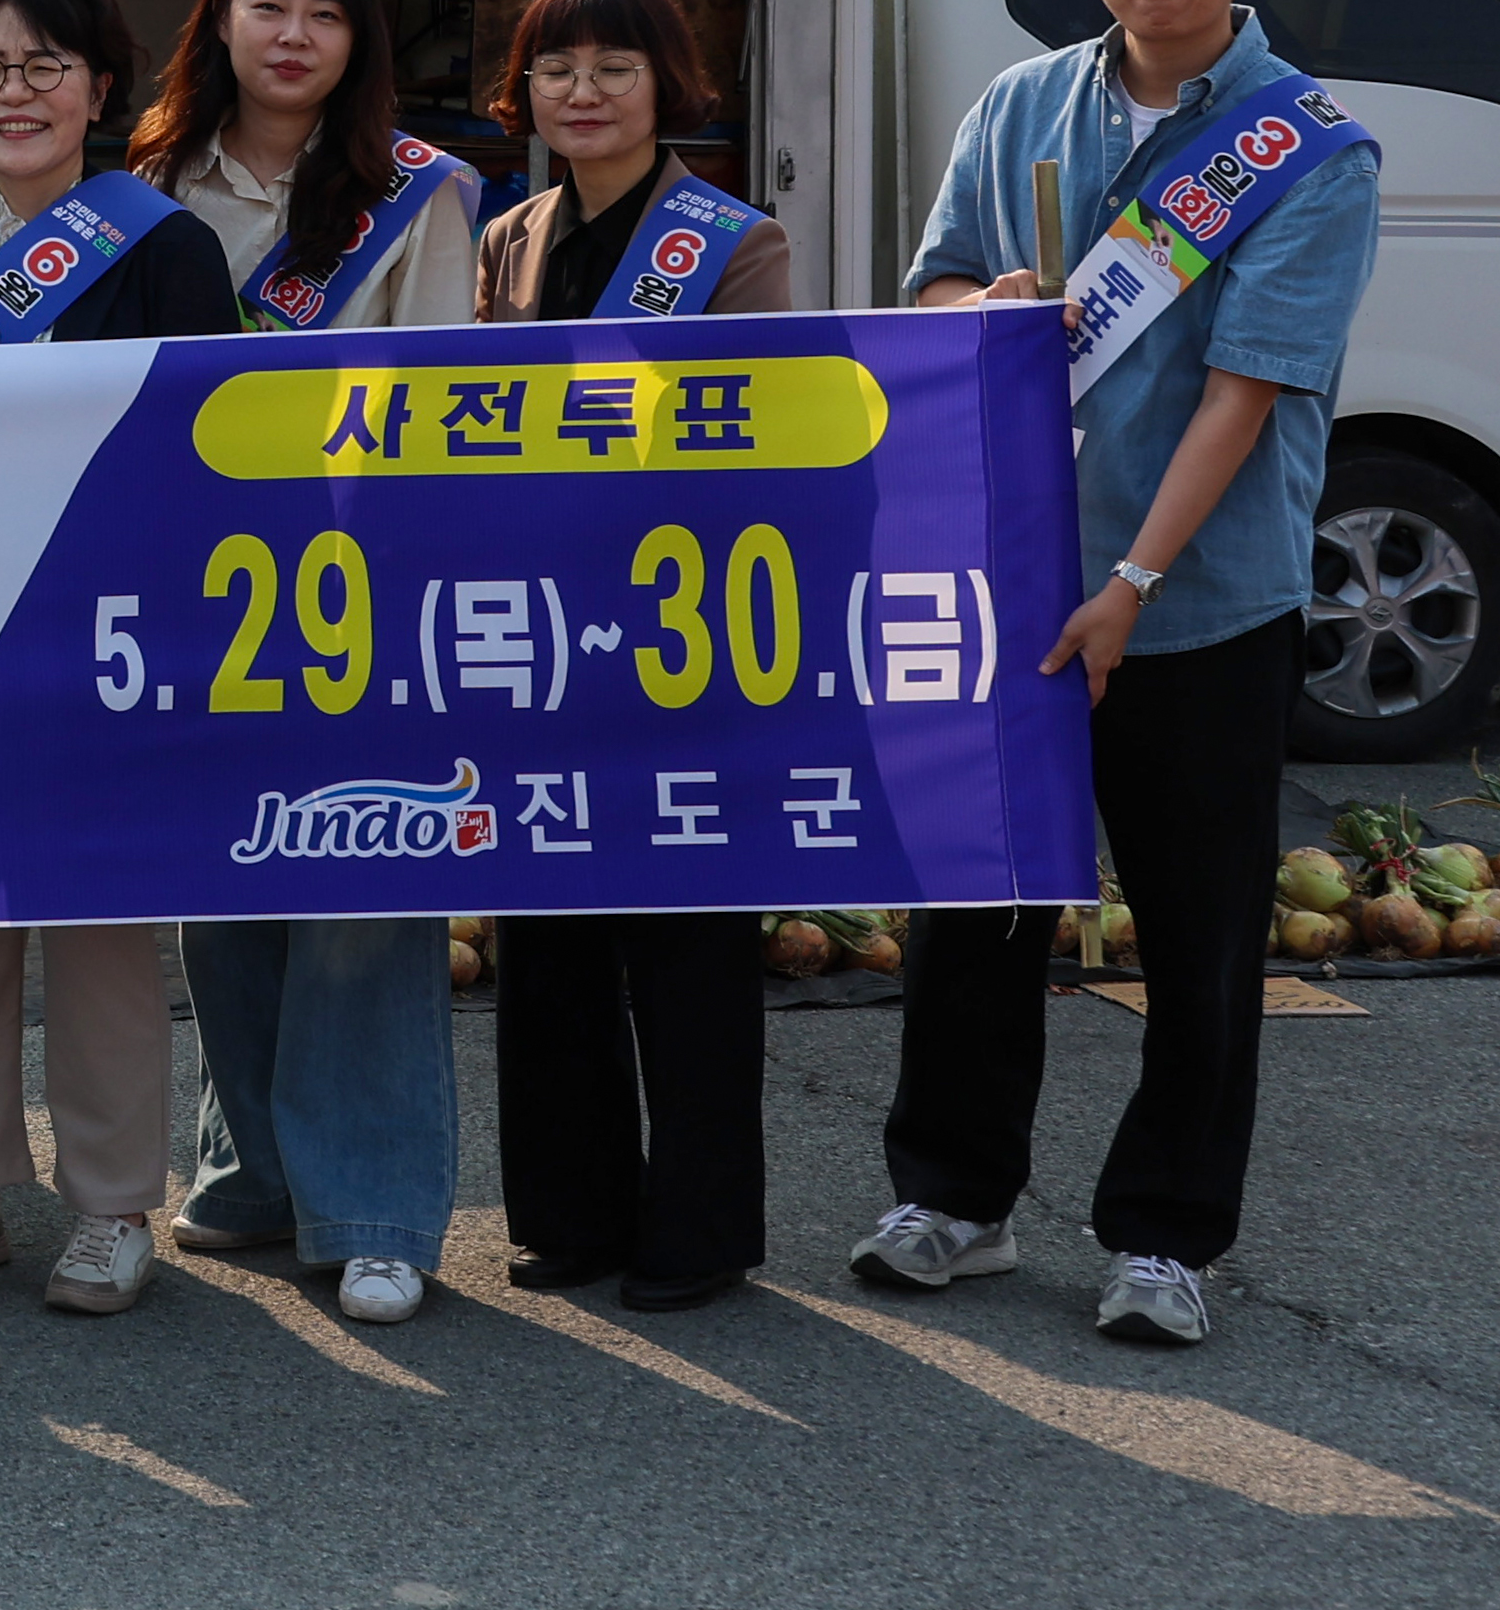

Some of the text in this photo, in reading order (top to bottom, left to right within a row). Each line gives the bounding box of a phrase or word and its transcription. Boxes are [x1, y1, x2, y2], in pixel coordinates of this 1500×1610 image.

[65, 198, 102, 226] 군민이
[663, 198, 743, 233] 살기좋은 진도
[676, 190, 717, 210] 군민이
[51, 206, 119, 259] 살기좋은 진도
[629, 228, 707, 317] 6월
[321, 372, 756, 460] 사전투표
[231, 790, 455, 864] Jindo
